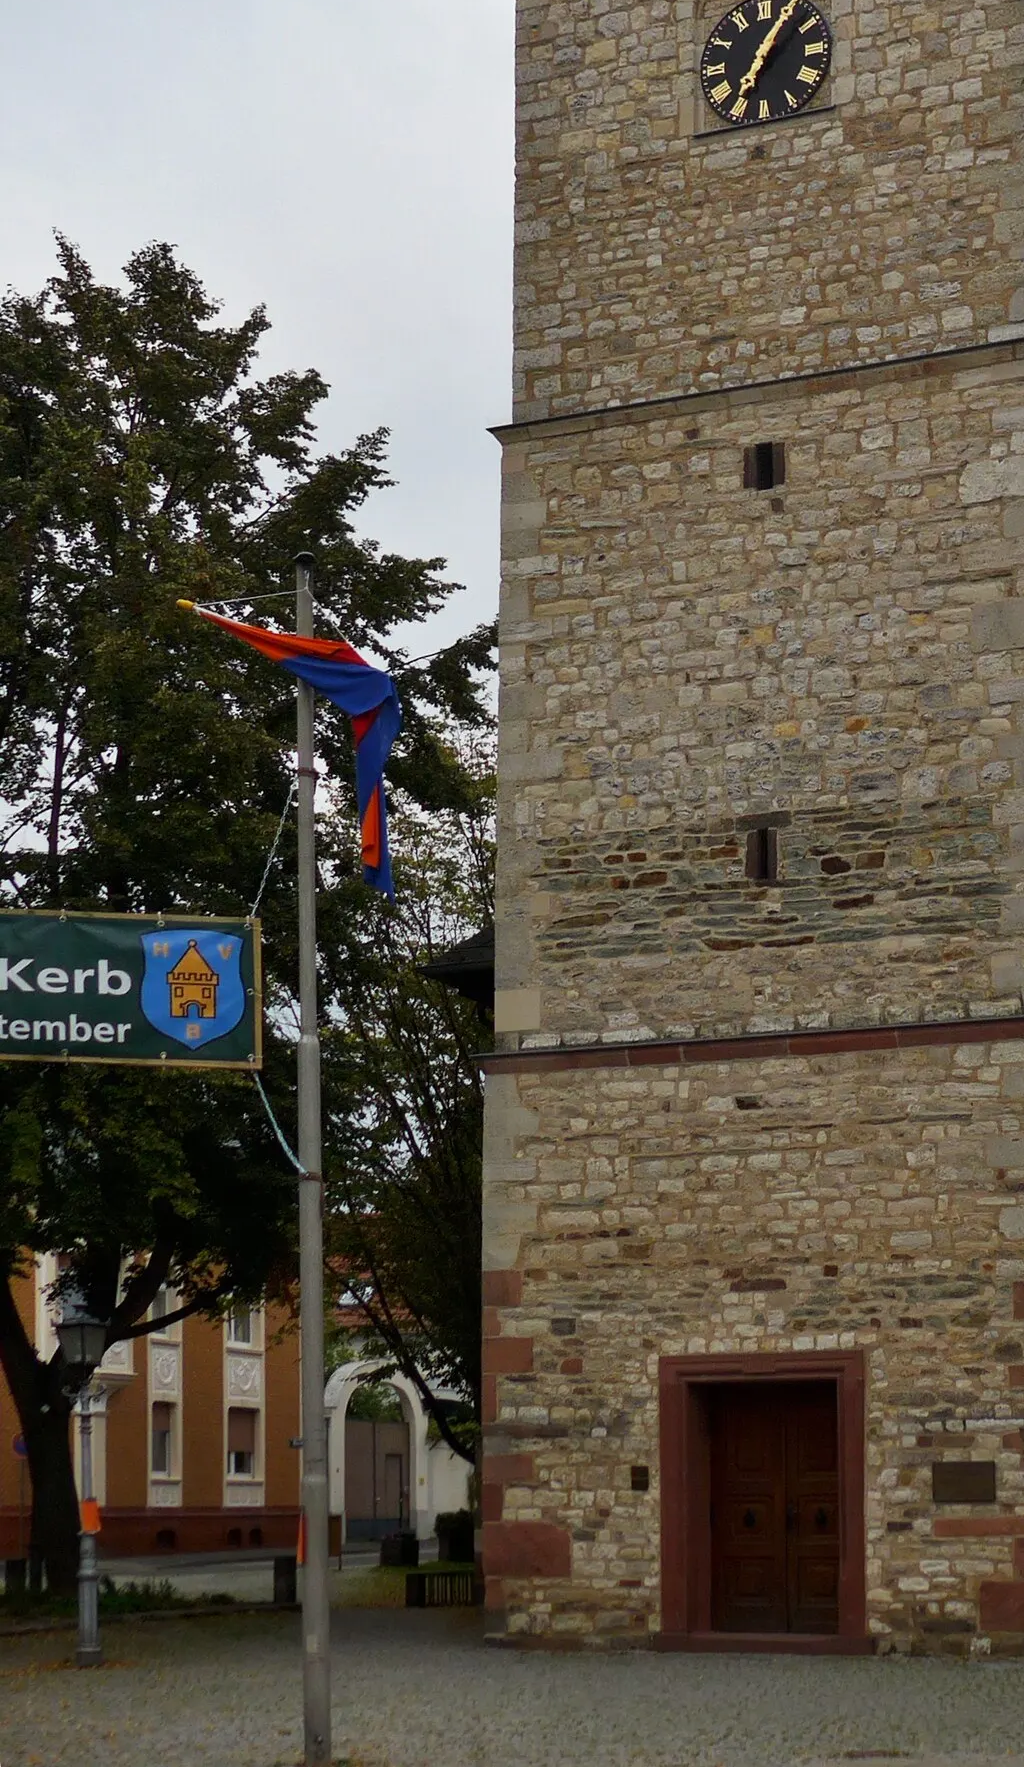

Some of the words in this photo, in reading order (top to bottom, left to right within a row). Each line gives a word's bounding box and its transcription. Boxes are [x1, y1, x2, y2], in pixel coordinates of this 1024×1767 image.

[757, 0, 772, 21] XII
[804, 41, 823, 56] III
[0, 958, 132, 995] Kerb
